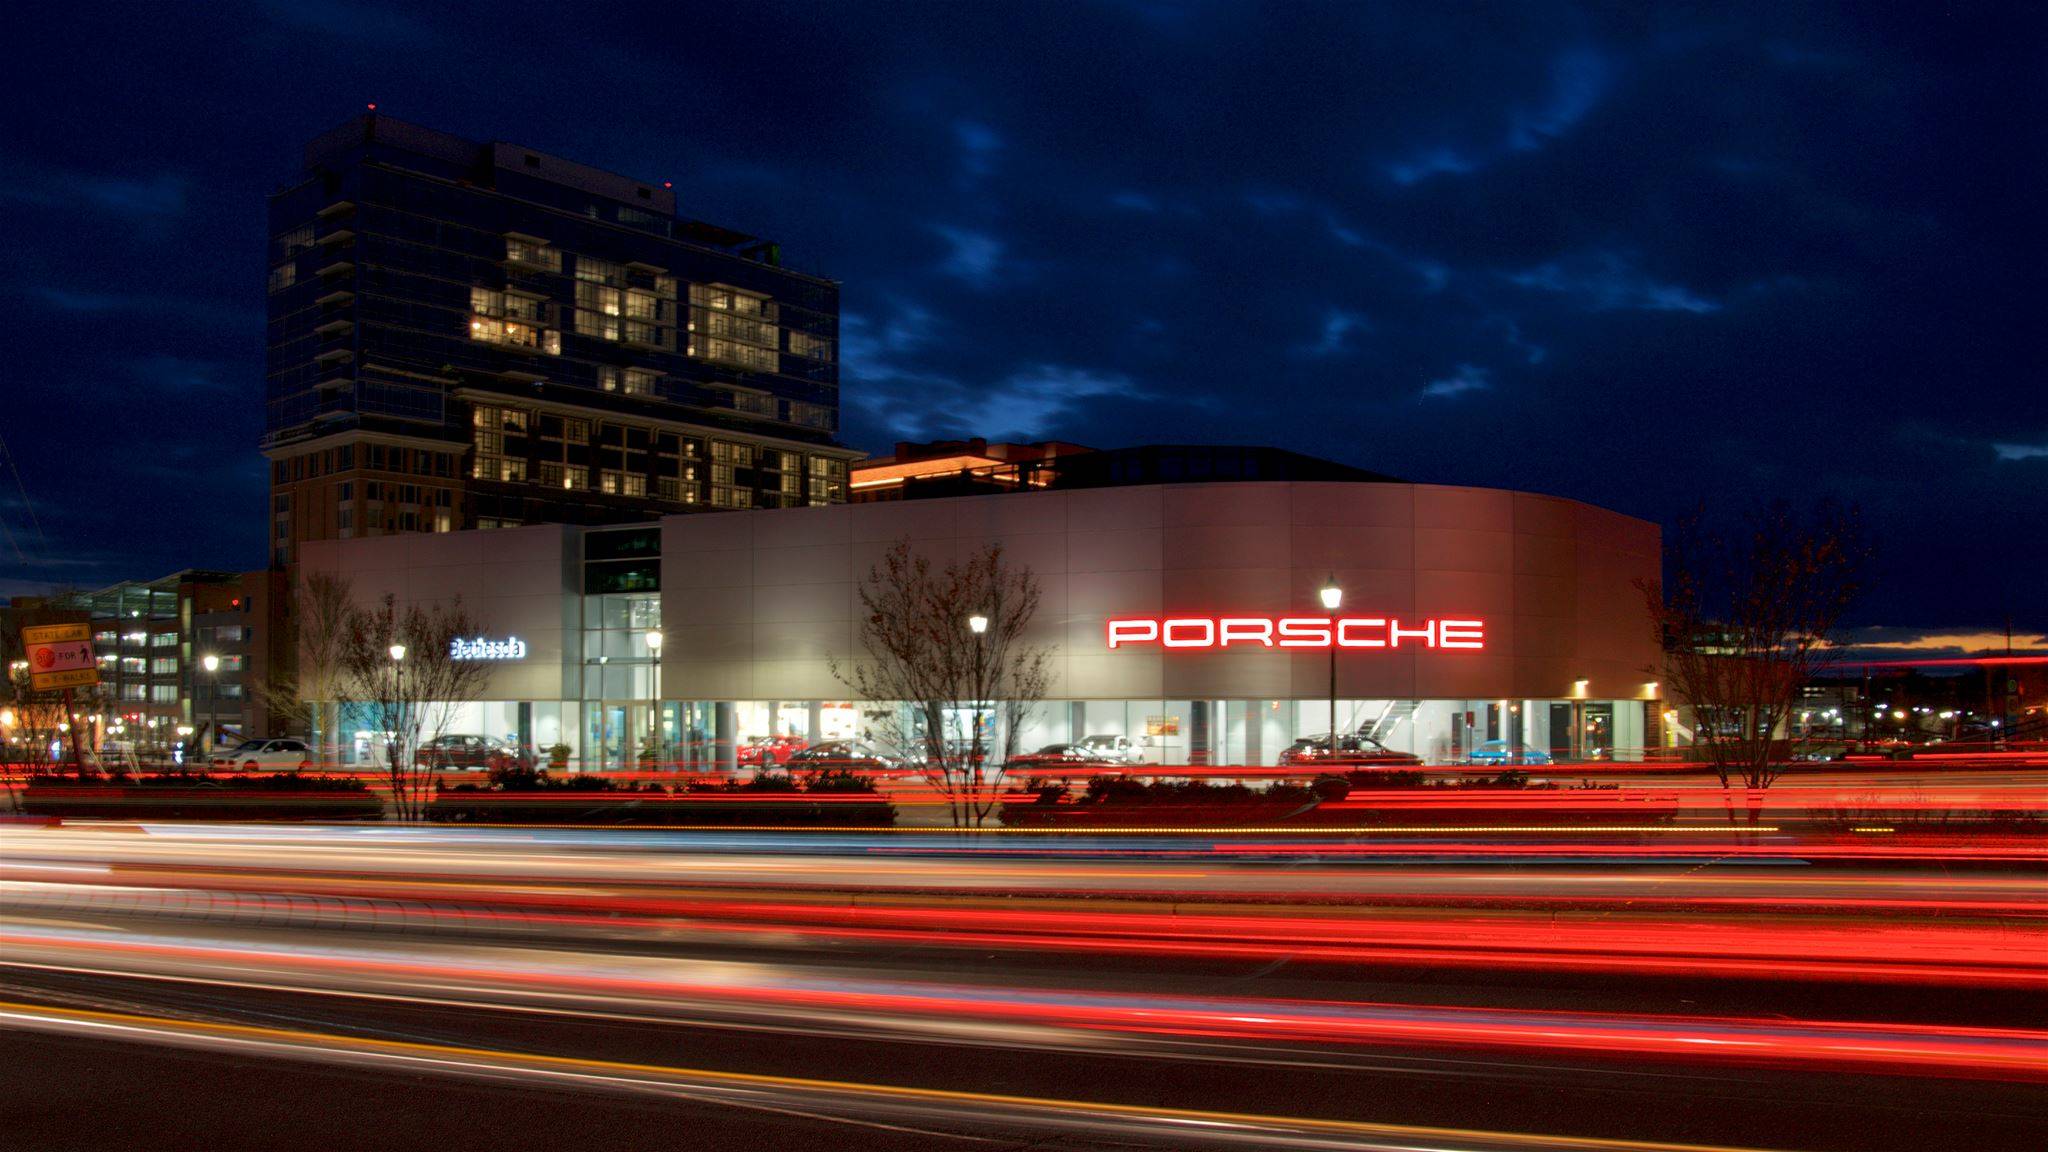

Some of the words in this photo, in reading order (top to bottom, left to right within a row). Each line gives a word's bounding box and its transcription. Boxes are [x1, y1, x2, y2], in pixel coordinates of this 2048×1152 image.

[1107, 617, 1484, 649] PORSCHE
[56, 651, 76, 661] FOR
[450, 637, 525, 658] Bethesda
